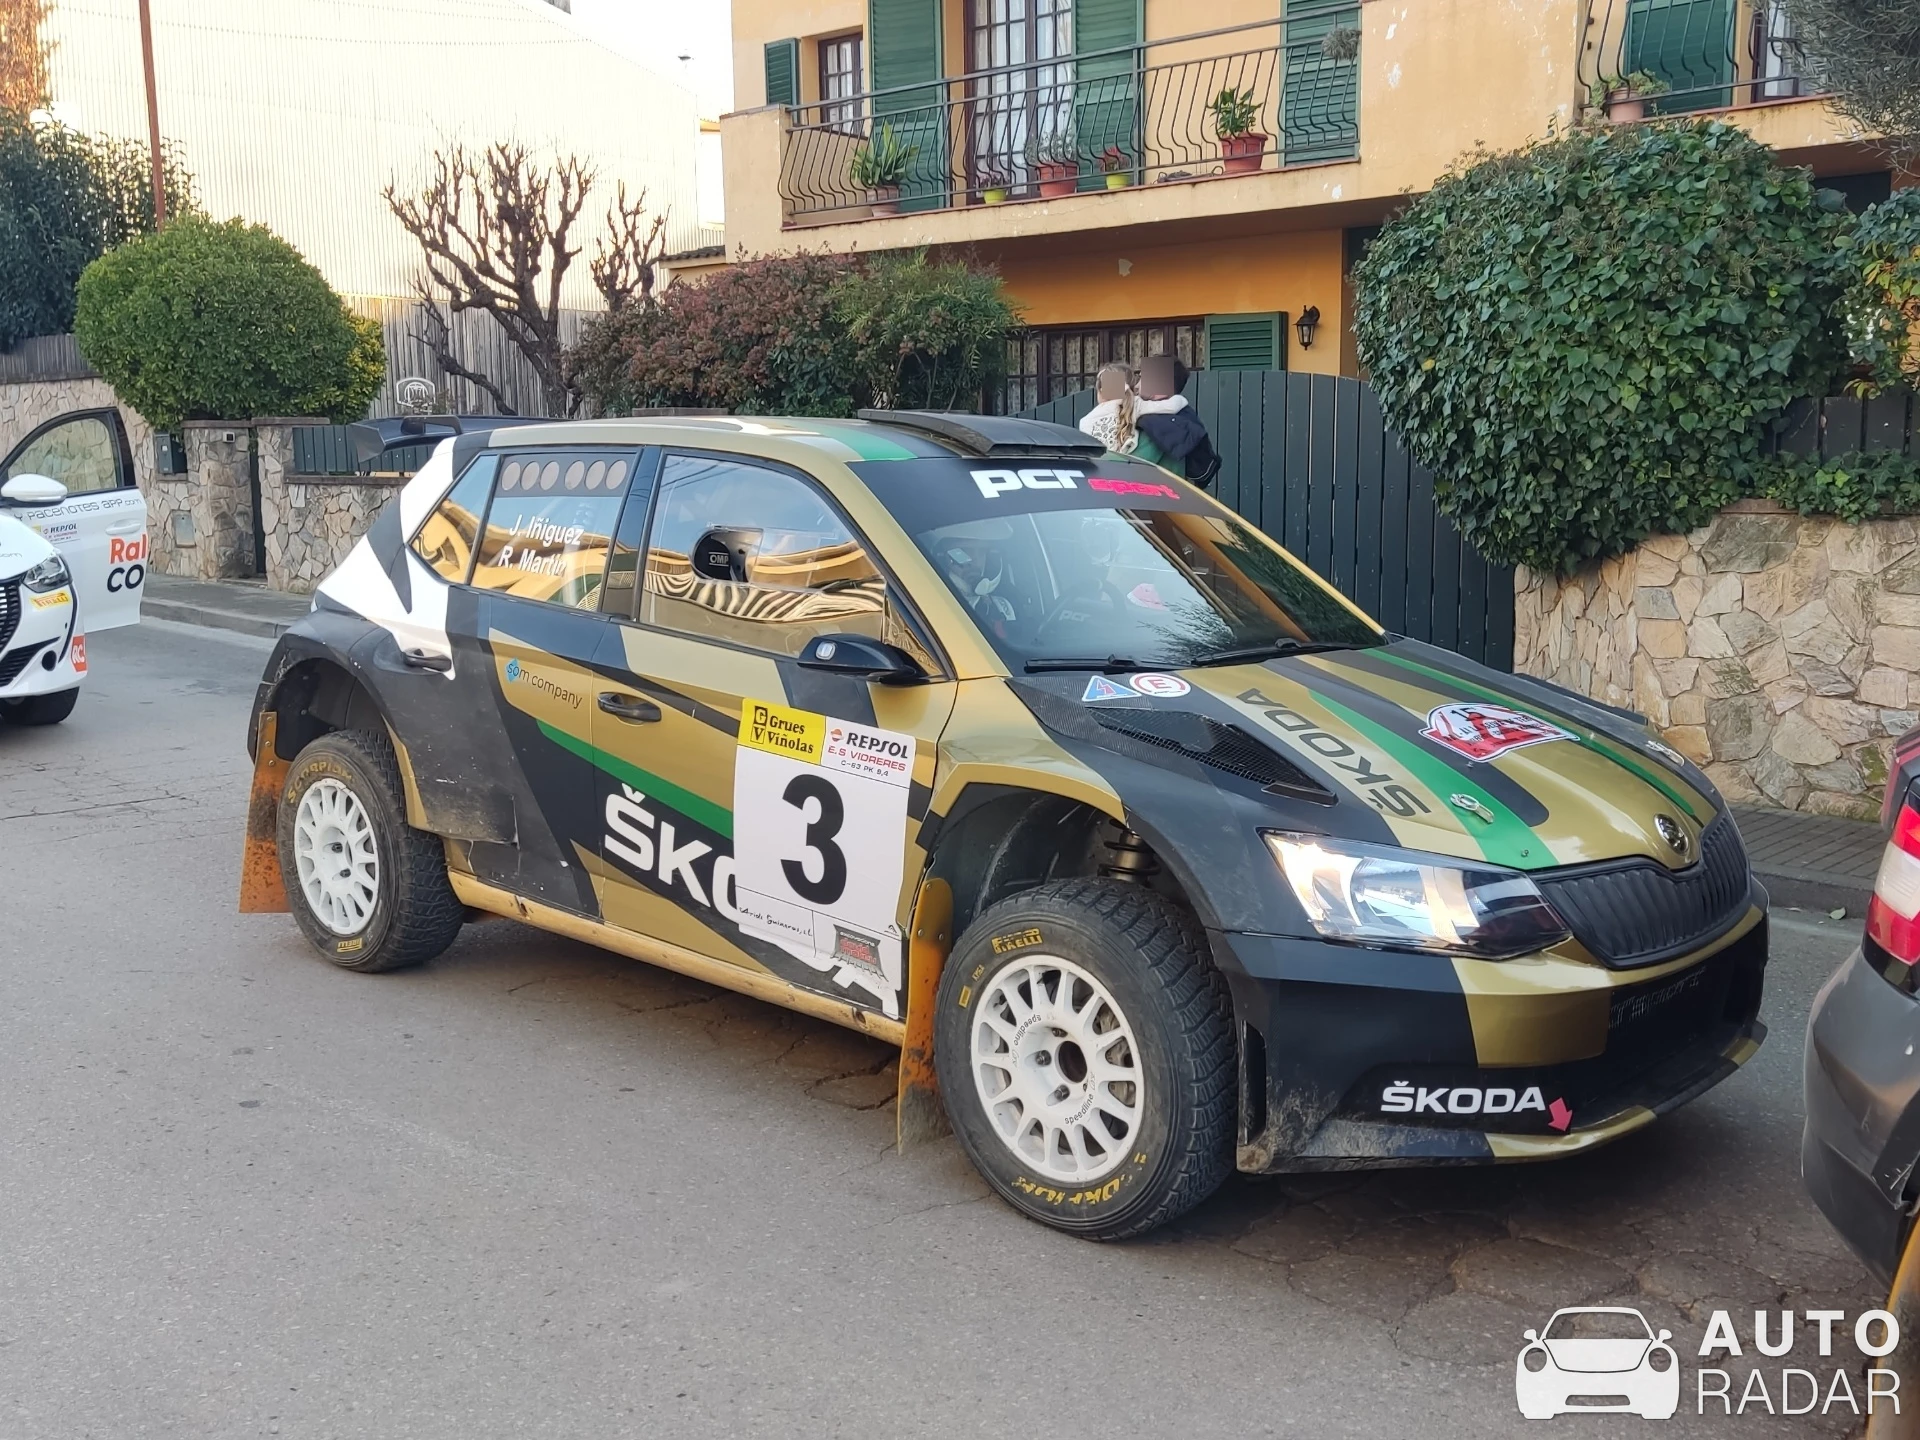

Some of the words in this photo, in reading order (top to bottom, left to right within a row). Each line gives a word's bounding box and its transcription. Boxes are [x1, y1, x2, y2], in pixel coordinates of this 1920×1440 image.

[970, 469, 1086, 499] pcr
[509, 514, 523, 537] J.
[525, 515, 585, 548] Iñiguez
[498, 545, 513, 569] R.
[709, 554, 729, 564] OMP
[507, 662, 530, 683] som
[531, 675, 583, 710] company
[1147, 679, 1173, 690] E
[769, 715, 805, 735] Grues
[828, 745, 847, 757] E.S
[850, 750, 907, 772] VIDRERES
[846, 732, 908, 759] REPSOL
[1236, 688, 1432, 817] ŠKODA
[863, 765, 874, 773] PK
[780, 774, 848, 906] 3
[992, 928, 1042, 954] PIRELLI
[1064, 1093, 1094, 1125] speedline
[1381, 1080, 1546, 1114] ŠKODA
